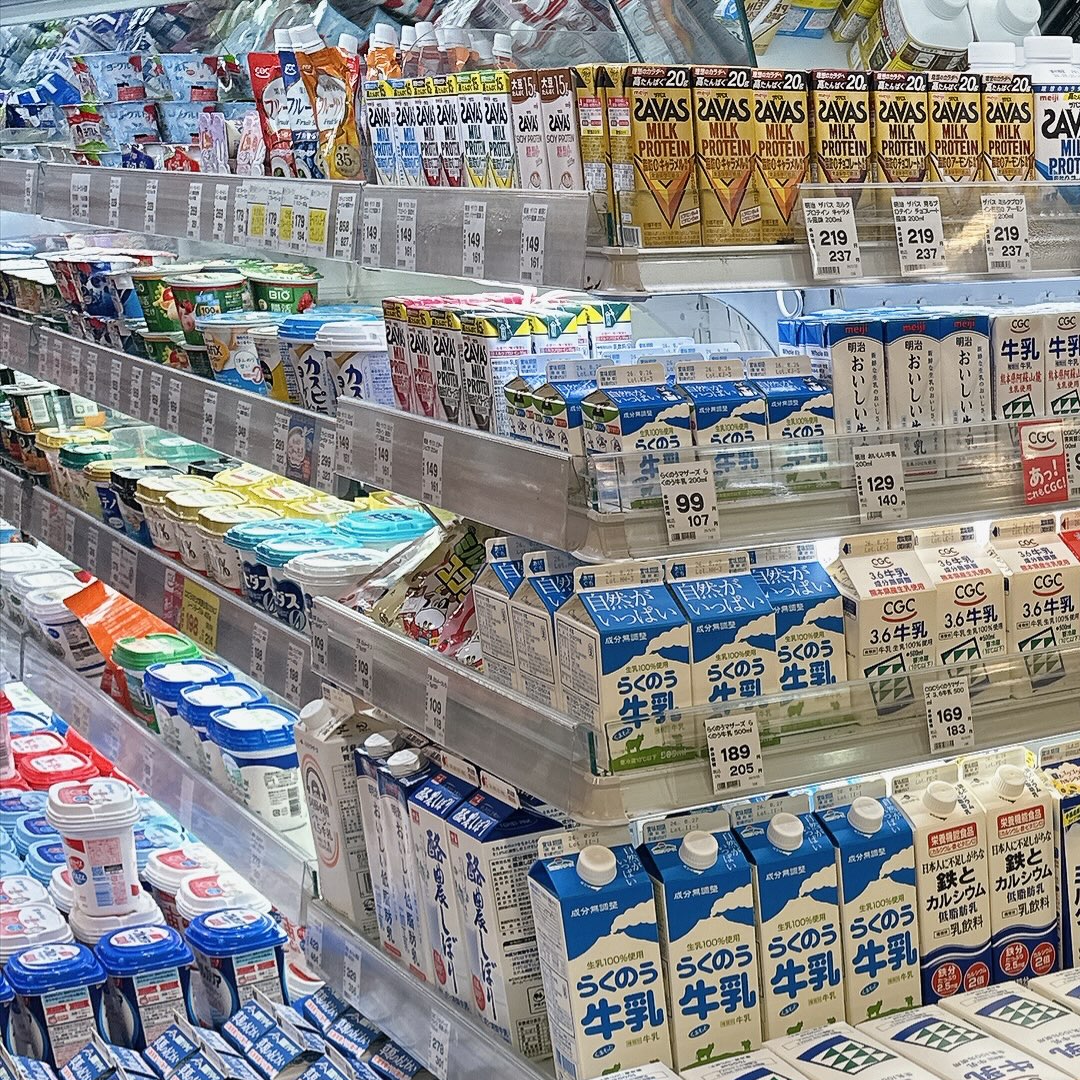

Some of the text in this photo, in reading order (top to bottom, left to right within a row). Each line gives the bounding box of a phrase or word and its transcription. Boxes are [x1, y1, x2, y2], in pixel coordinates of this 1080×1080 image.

[647, 123, 676, 139] MILK
[638, 141, 690, 158] PROTEIN
[336, 152, 352, 167] 35
[525, 236, 540, 252] 149
[819, 229, 848, 246] 219
[829, 249, 851, 262] 237
[845, 324, 869, 335] meiji
[1011, 319, 1030, 329] CGC
[847, 342, 866, 353] 明治
[1000, 337, 1040, 362] 牛乳
[781, 425, 825, 440] らくのう
[1027, 430, 1055, 444] CGC
[866, 475, 895, 492] 129
[676, 493, 705, 513] 99
[878, 494, 898, 506] 140
[687, 514, 709, 527] 107
[1033, 573, 1063, 590] CGC
[586, 590, 653, 612] 自然が
[883, 598, 916, 616] CGC
[1022, 595, 1075, 619] 3.6牛乳
[600, 606, 677, 627] いっぱい
[869, 621, 928, 645] 3.6牛乳
[617, 670, 678, 695] らくのう
[619, 691, 681, 729] 牛乳
[936, 706, 963, 723] 169
[946, 723, 966, 736] 183
[721, 744, 750, 762] 189
[729, 763, 754, 776] 205
[922, 848, 985, 875] 日本人に不足しがちな
[937, 865, 976, 894] 鉄と
[926, 883, 987, 912] カルシウム
[571, 900, 619, 919] 成分無調整
[938, 903, 978, 924] 低脂肪乳
[850, 904, 915, 940] らくのう
[950, 915, 984, 938] 乳飲料
[586, 950, 645, 969] 生乳100%使用
[852, 930, 918, 978] 牛乳
[577, 960, 659, 998] らくのう
[581, 990, 664, 1040] 牛乳
